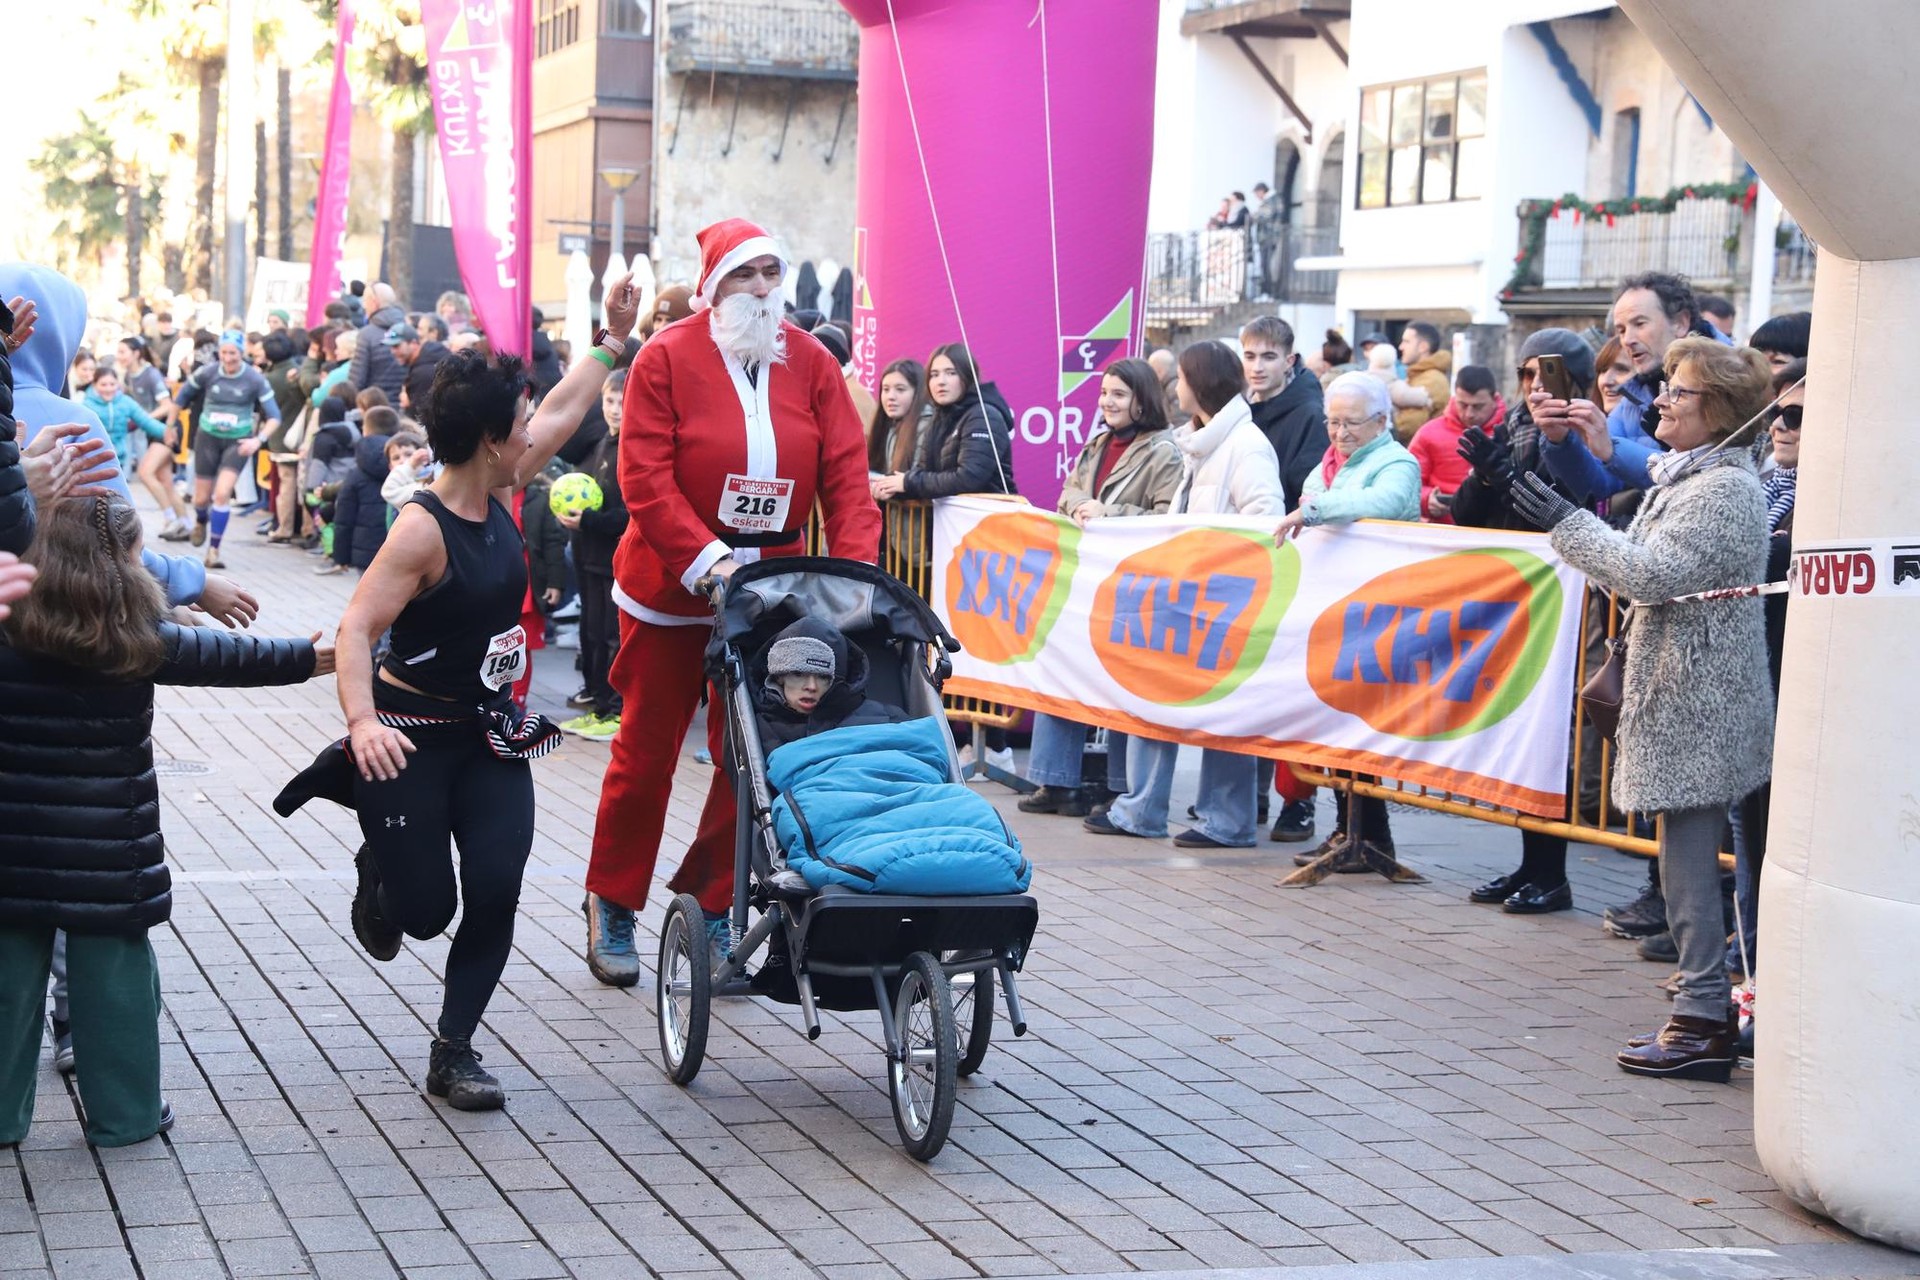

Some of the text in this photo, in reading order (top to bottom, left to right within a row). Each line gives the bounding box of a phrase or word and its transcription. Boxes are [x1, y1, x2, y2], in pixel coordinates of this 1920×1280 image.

[864, 316, 877, 393] kutxa
[739, 484, 778, 495] BERGARA
[734, 495, 777, 516] 216
[731, 517, 771, 528] eskatu
[1800, 552, 1876, 596] GARA
[487, 650, 520, 677] 190
